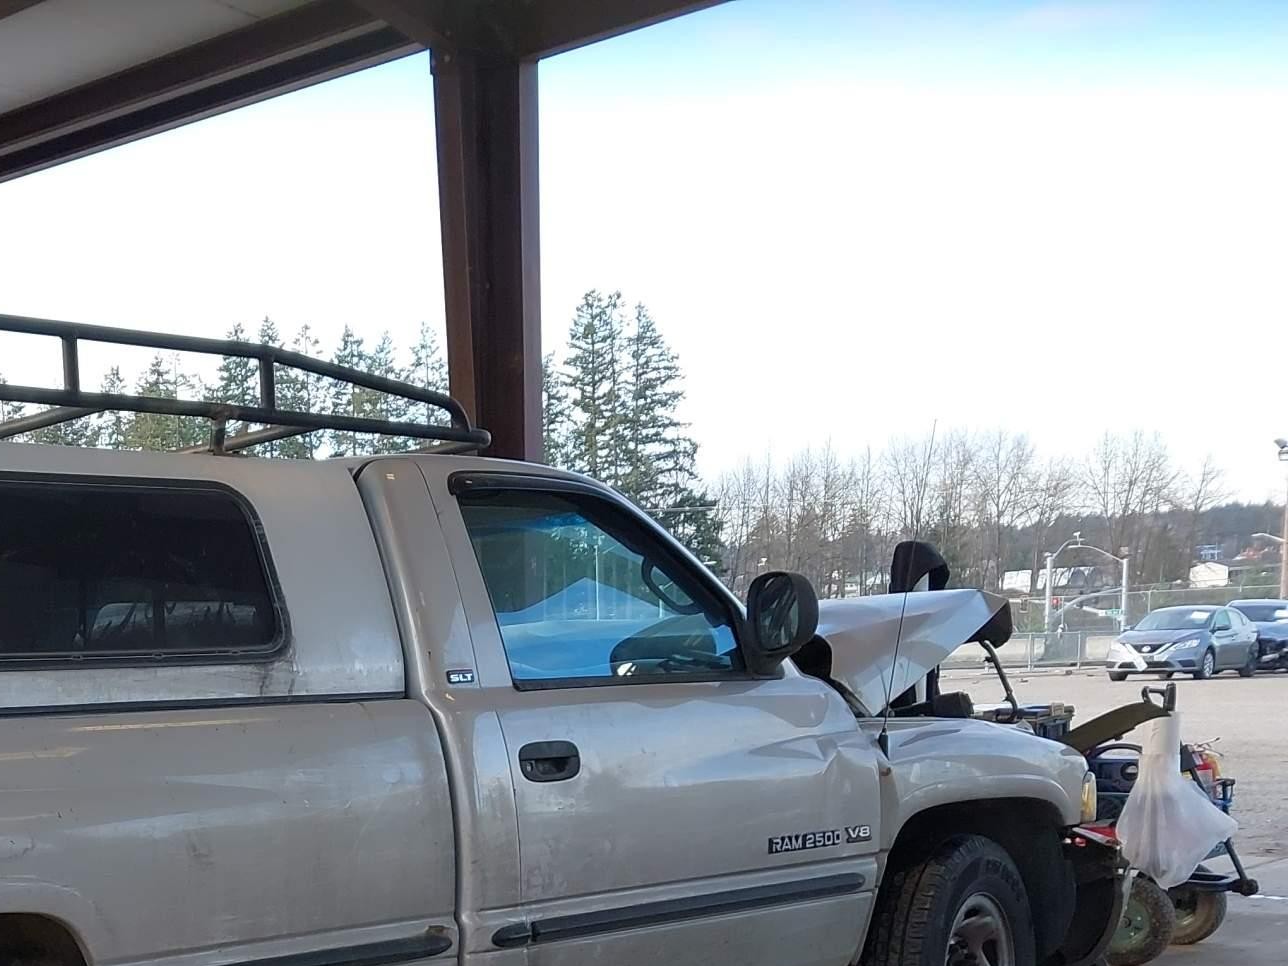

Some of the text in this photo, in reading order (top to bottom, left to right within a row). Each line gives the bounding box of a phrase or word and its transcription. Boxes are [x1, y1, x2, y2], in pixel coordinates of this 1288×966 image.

[450, 673, 472, 682] SLT
[771, 825, 871, 852] RAM 2500 V8
